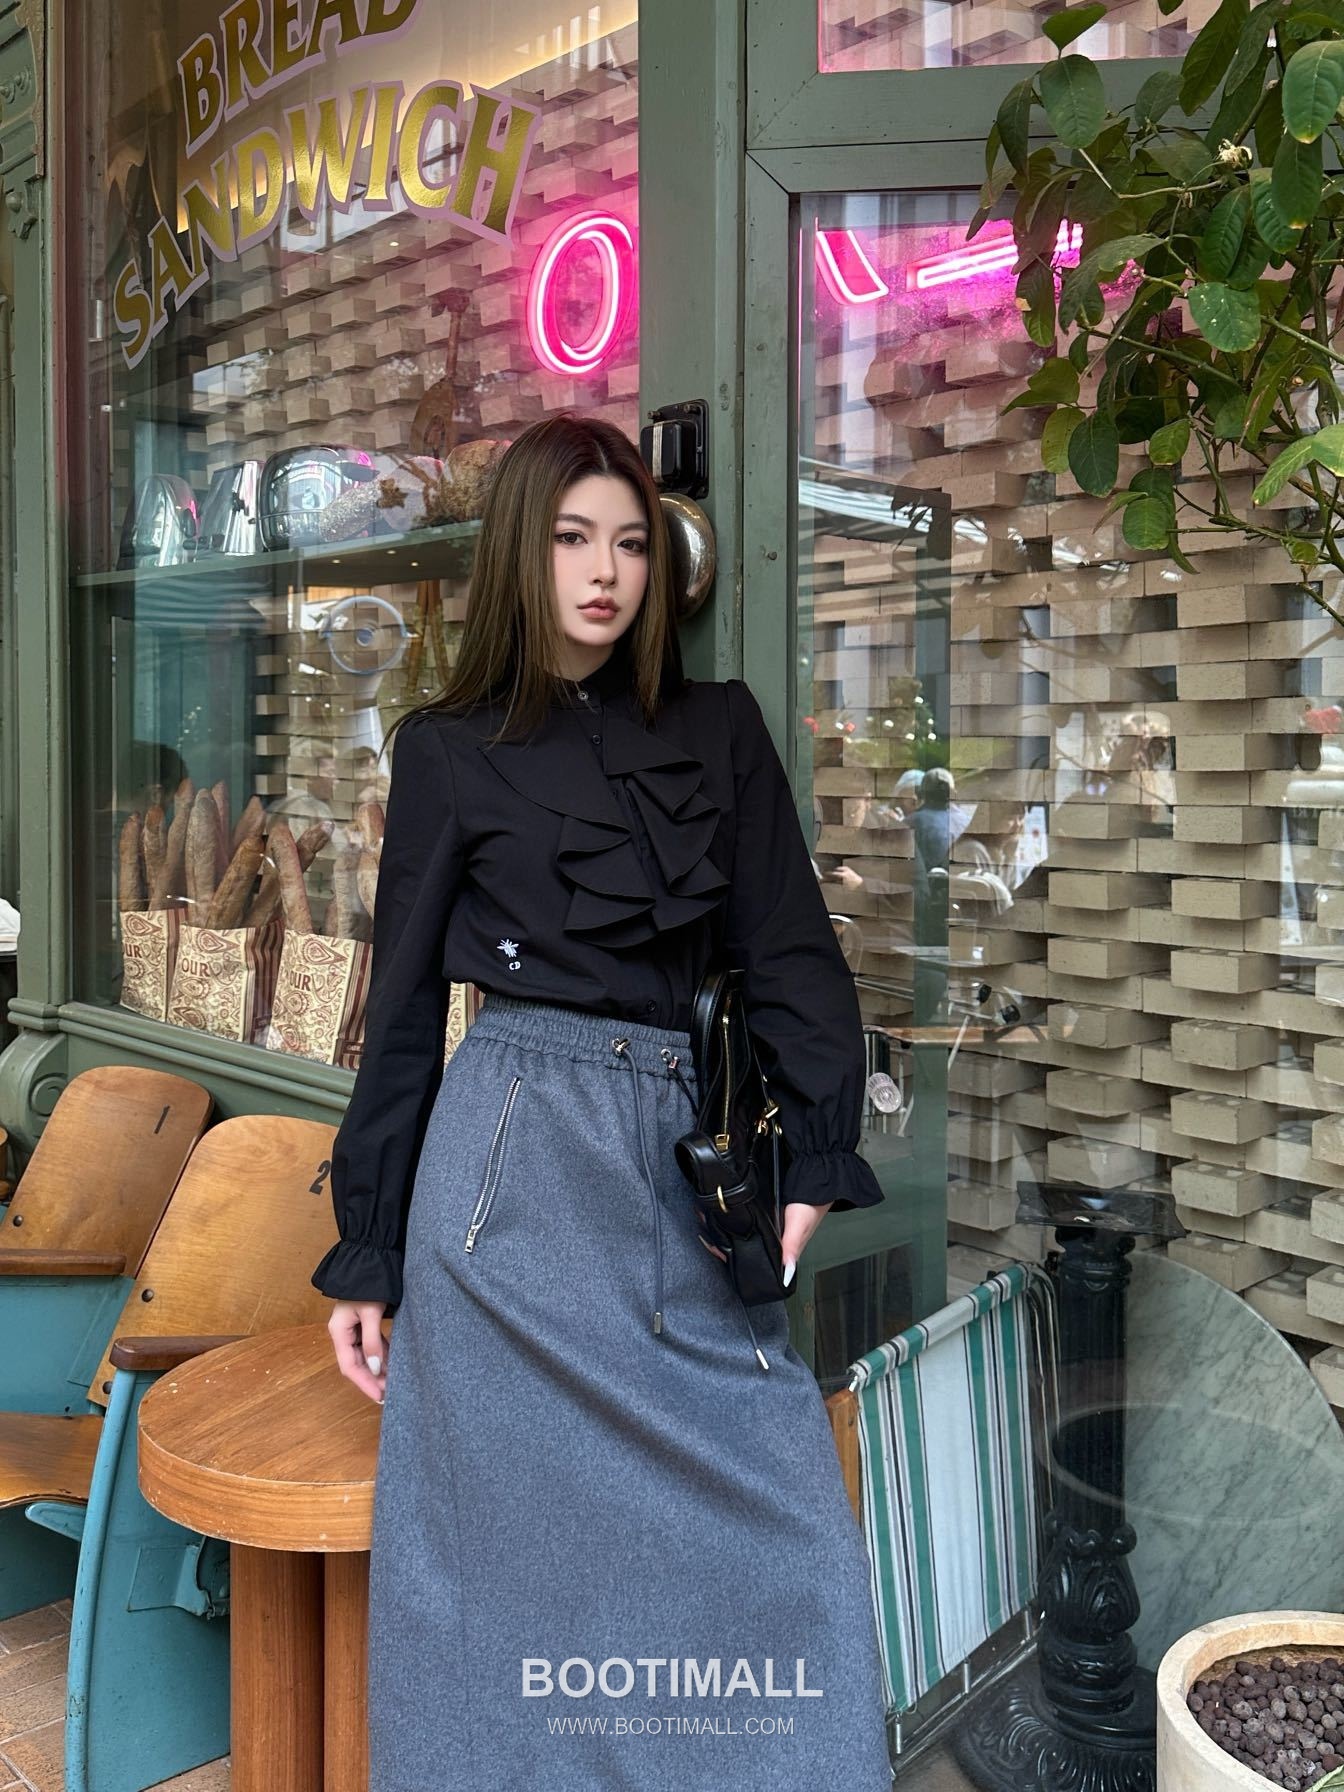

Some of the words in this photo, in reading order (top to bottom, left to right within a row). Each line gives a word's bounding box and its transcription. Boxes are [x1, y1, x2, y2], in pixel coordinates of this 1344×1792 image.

[114, 80, 541, 368] SANDWICH
[182, 958, 210, 977] OUR
[154, 1105, 170, 1134] 1
[309, 1160, 331, 1195] 2
